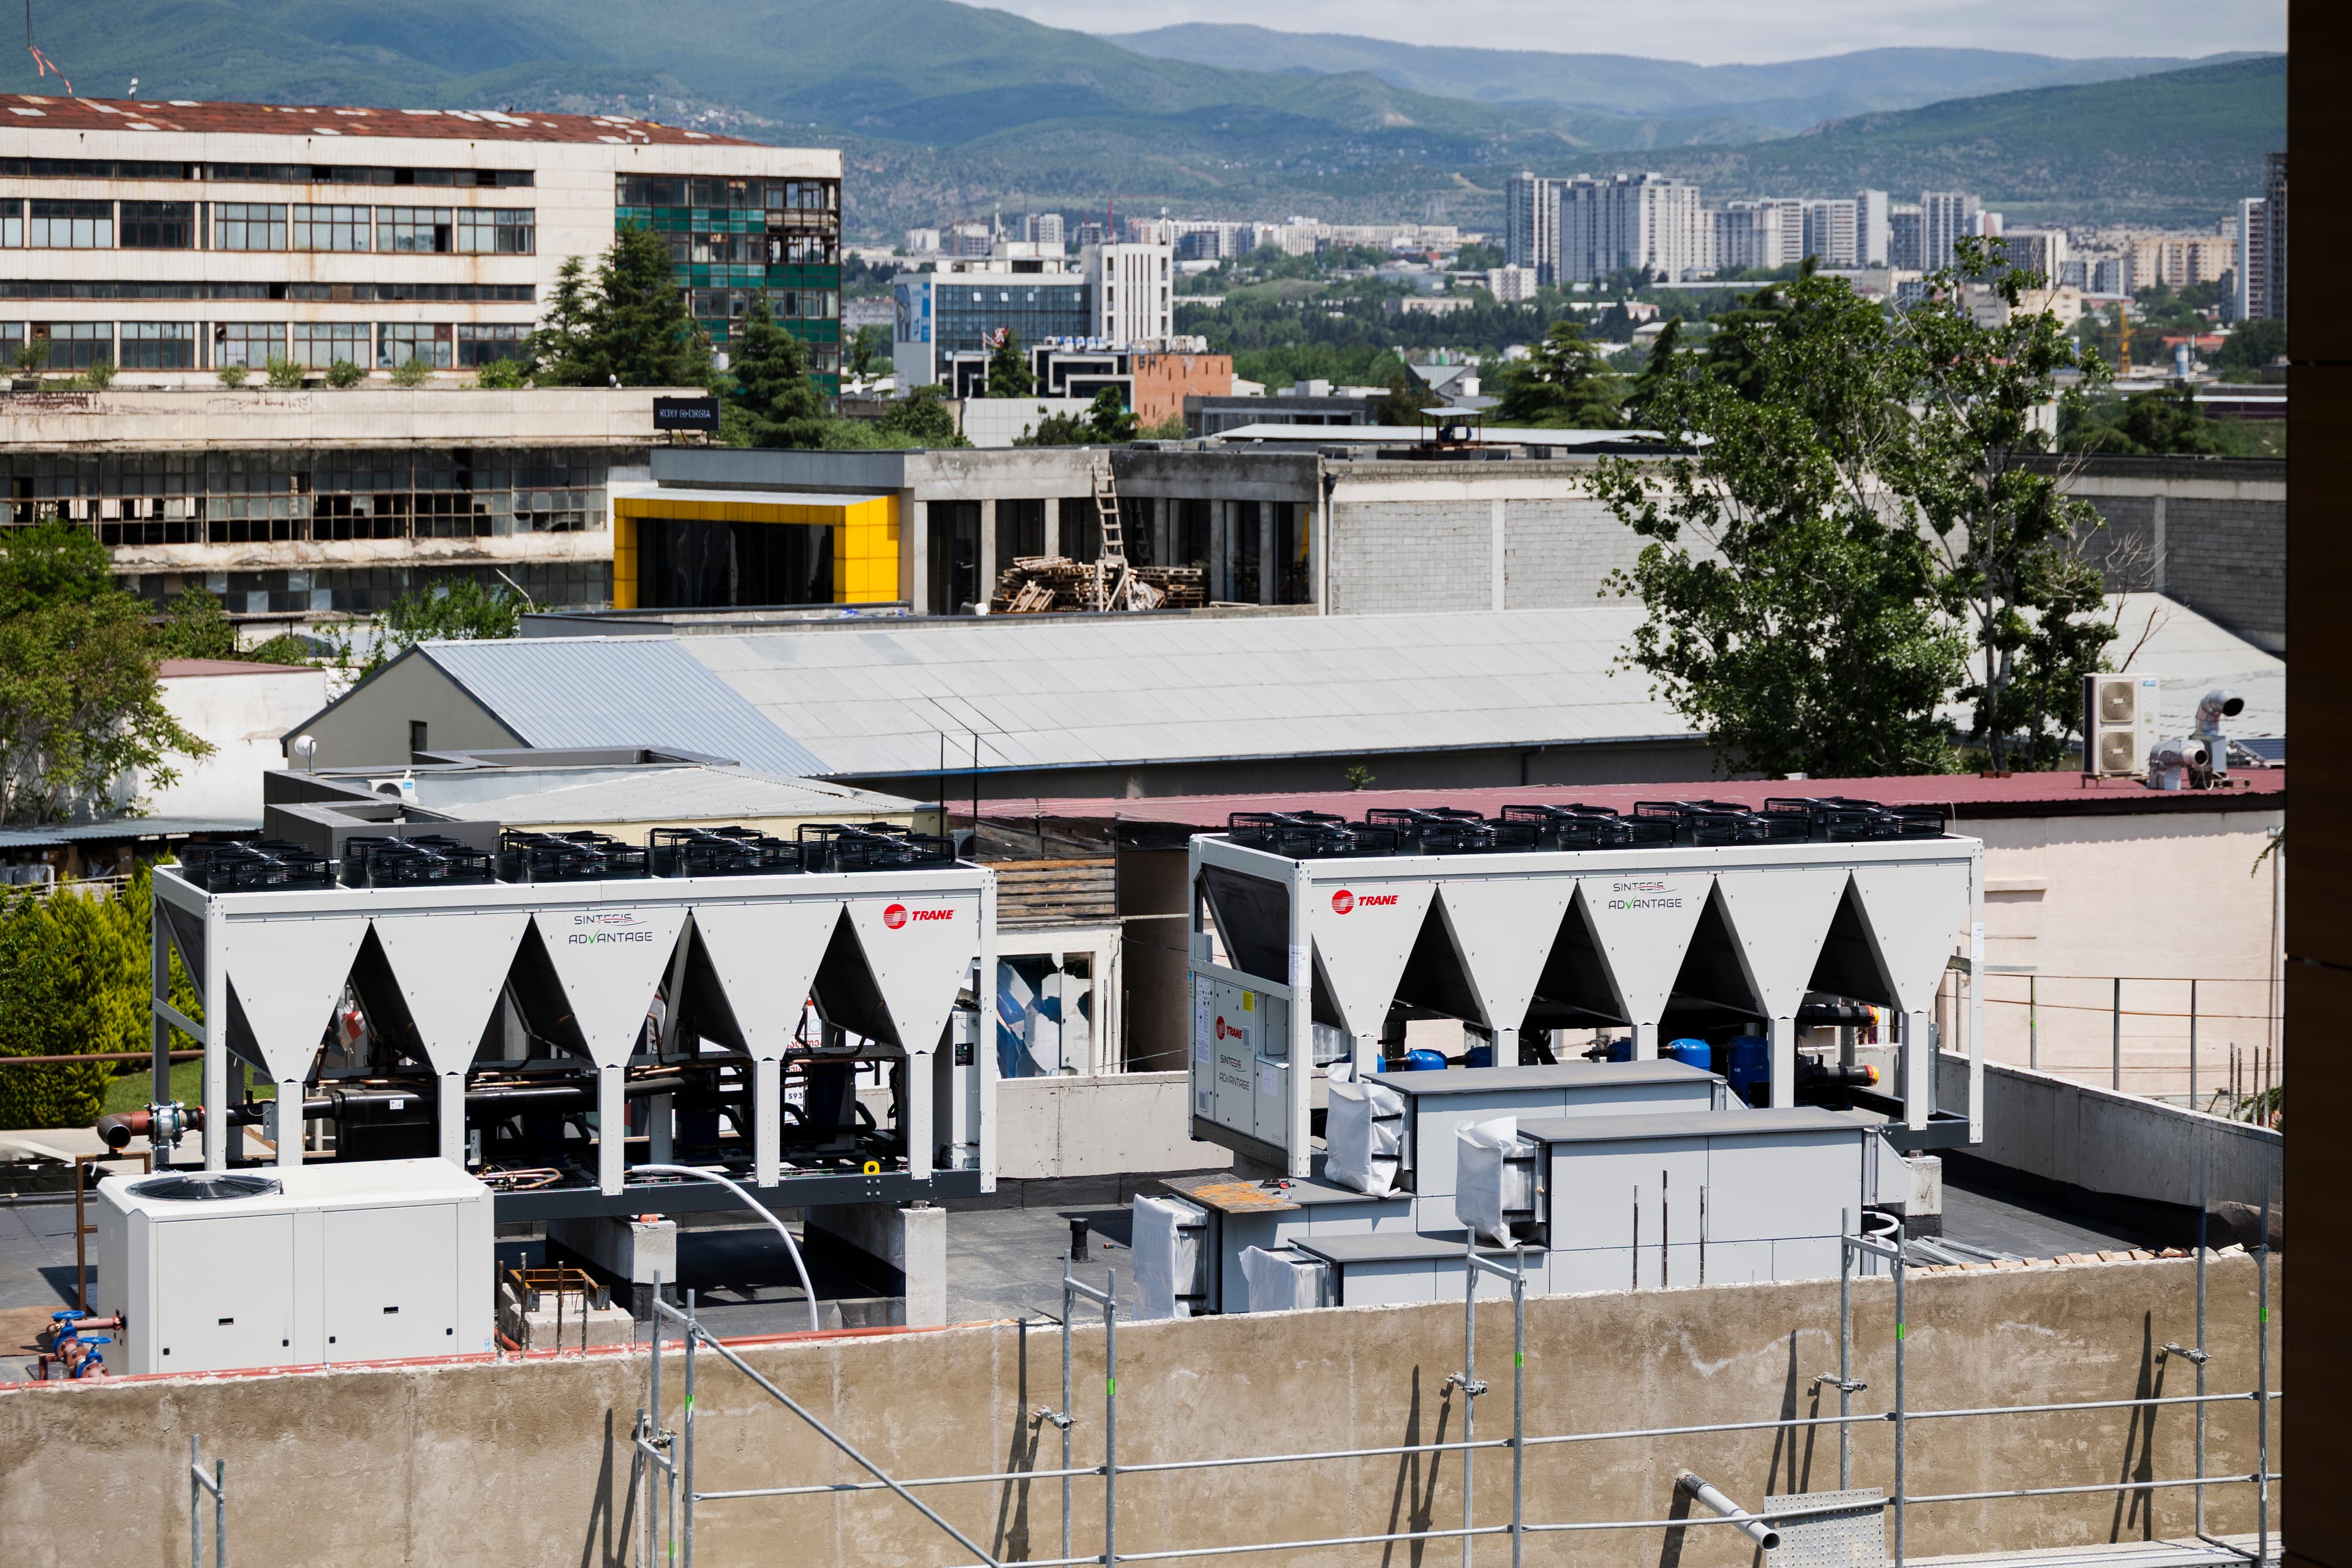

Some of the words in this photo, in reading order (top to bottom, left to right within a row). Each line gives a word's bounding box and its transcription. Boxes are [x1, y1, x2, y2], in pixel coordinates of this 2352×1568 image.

[1613, 882, 1664, 892] SINTESIS
[1359, 895, 1398, 906] TRANE
[1608, 895, 1682, 910] ADVANTAGE
[574, 913, 632, 925] SINTESIS
[912, 910, 954, 921] TRANE
[569, 929, 652, 944] ADVANTAGE
[1226, 1025, 1242, 1039] TRANE
[1219, 1072, 1250, 1091] ADVANTAGE
